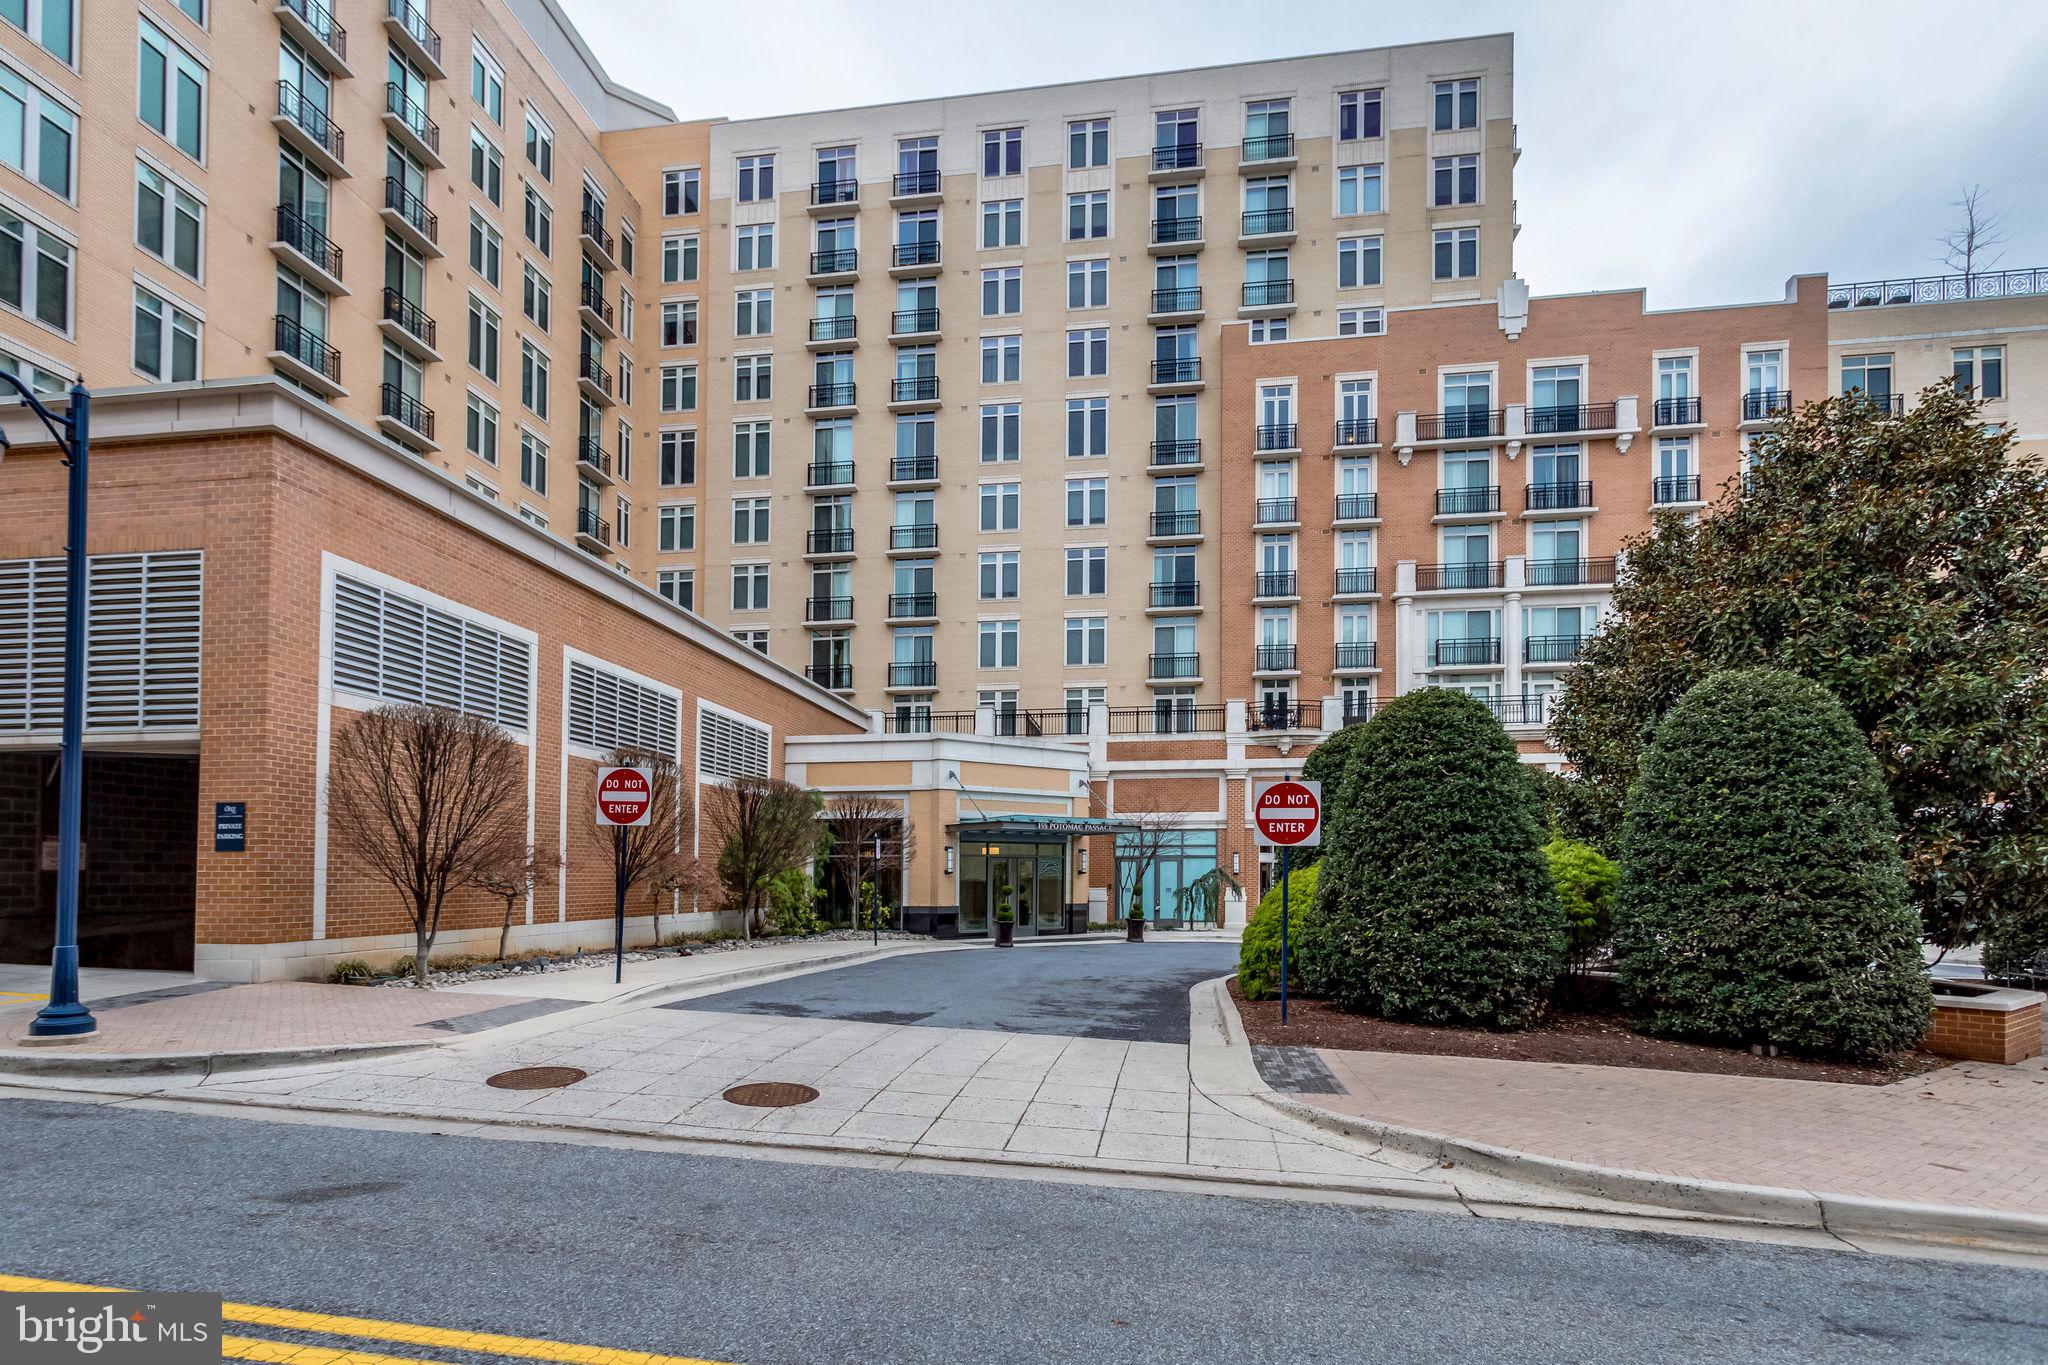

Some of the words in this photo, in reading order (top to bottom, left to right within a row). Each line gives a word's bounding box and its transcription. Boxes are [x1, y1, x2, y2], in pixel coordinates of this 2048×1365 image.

[606, 779, 619, 789] DO
[624, 779, 643, 789] NOT
[1265, 794, 1281, 805] DO
[1287, 794, 1310, 805] NOT
[608, 804, 639, 813] ENTER
[1049, 823, 1082, 831] POTOMAC
[1269, 822, 1305, 833] ENTER
